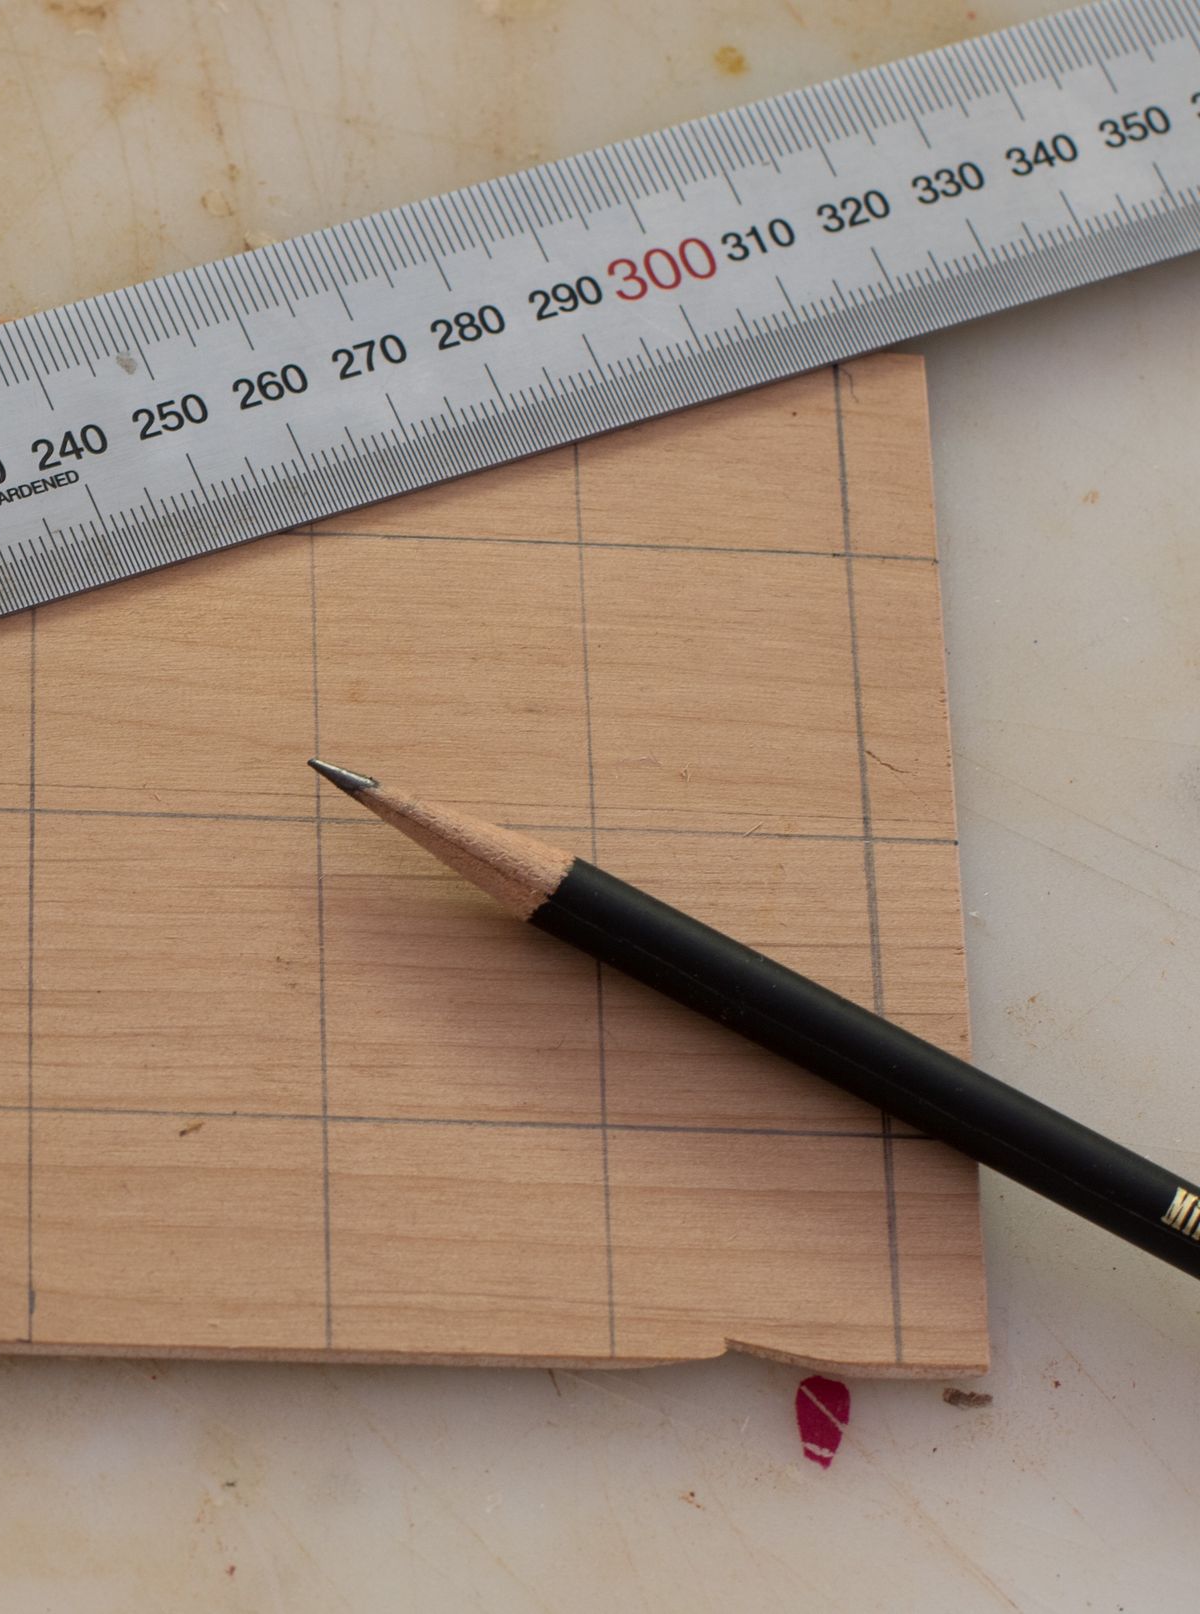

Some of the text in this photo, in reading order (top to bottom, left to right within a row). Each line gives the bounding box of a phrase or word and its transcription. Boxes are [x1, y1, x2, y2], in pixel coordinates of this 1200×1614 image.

[31, 424, 108, 471] 240
[132, 394, 208, 440] 250
[232, 364, 308, 410] 260
[332, 334, 407, 380] 270
[430, 305, 505, 350] 280
[528, 276, 603, 321] 290
[607, 238, 717, 301] 300
[721, 218, 796, 262] 310
[817, 190, 891, 233] 320
[911, 161, 985, 205] 330
[1005, 133, 1079, 176] 340
[1098, 106, 1172, 148] 350
[1160, 1186, 1200, 1241] Mi
